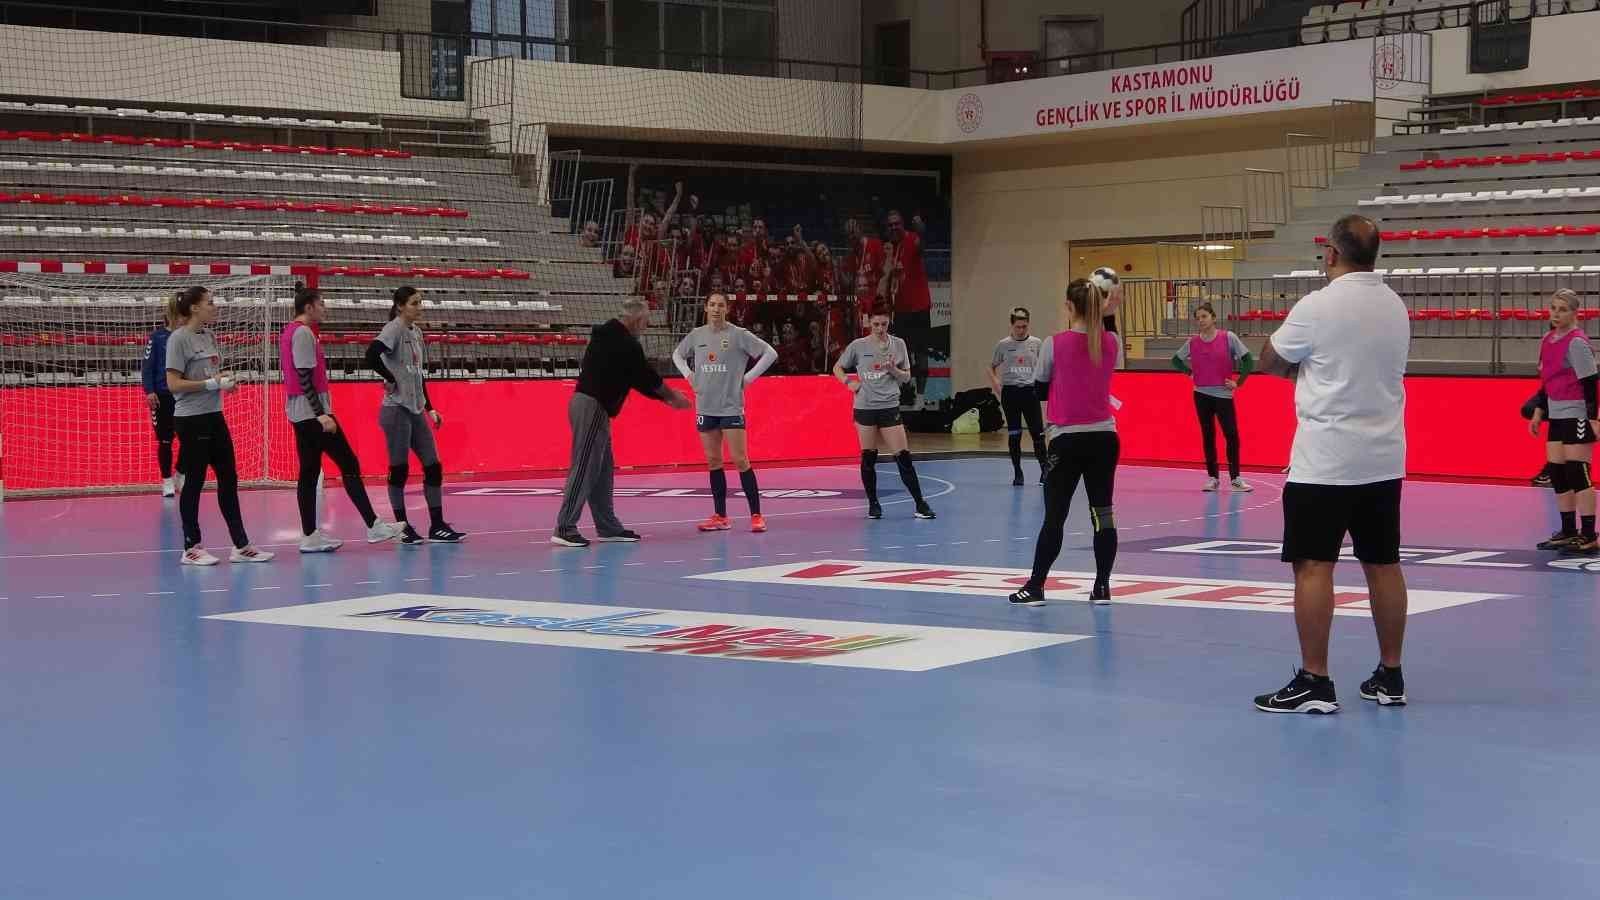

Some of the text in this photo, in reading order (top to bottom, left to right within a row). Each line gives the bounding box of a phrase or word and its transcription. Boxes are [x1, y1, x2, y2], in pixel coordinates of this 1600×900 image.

[1110, 64, 1213, 93] KASTAMONU
[1036, 78, 1301, 128] GENÇLİK VE SPOR İL MÜDÜRLÜĞÜ
